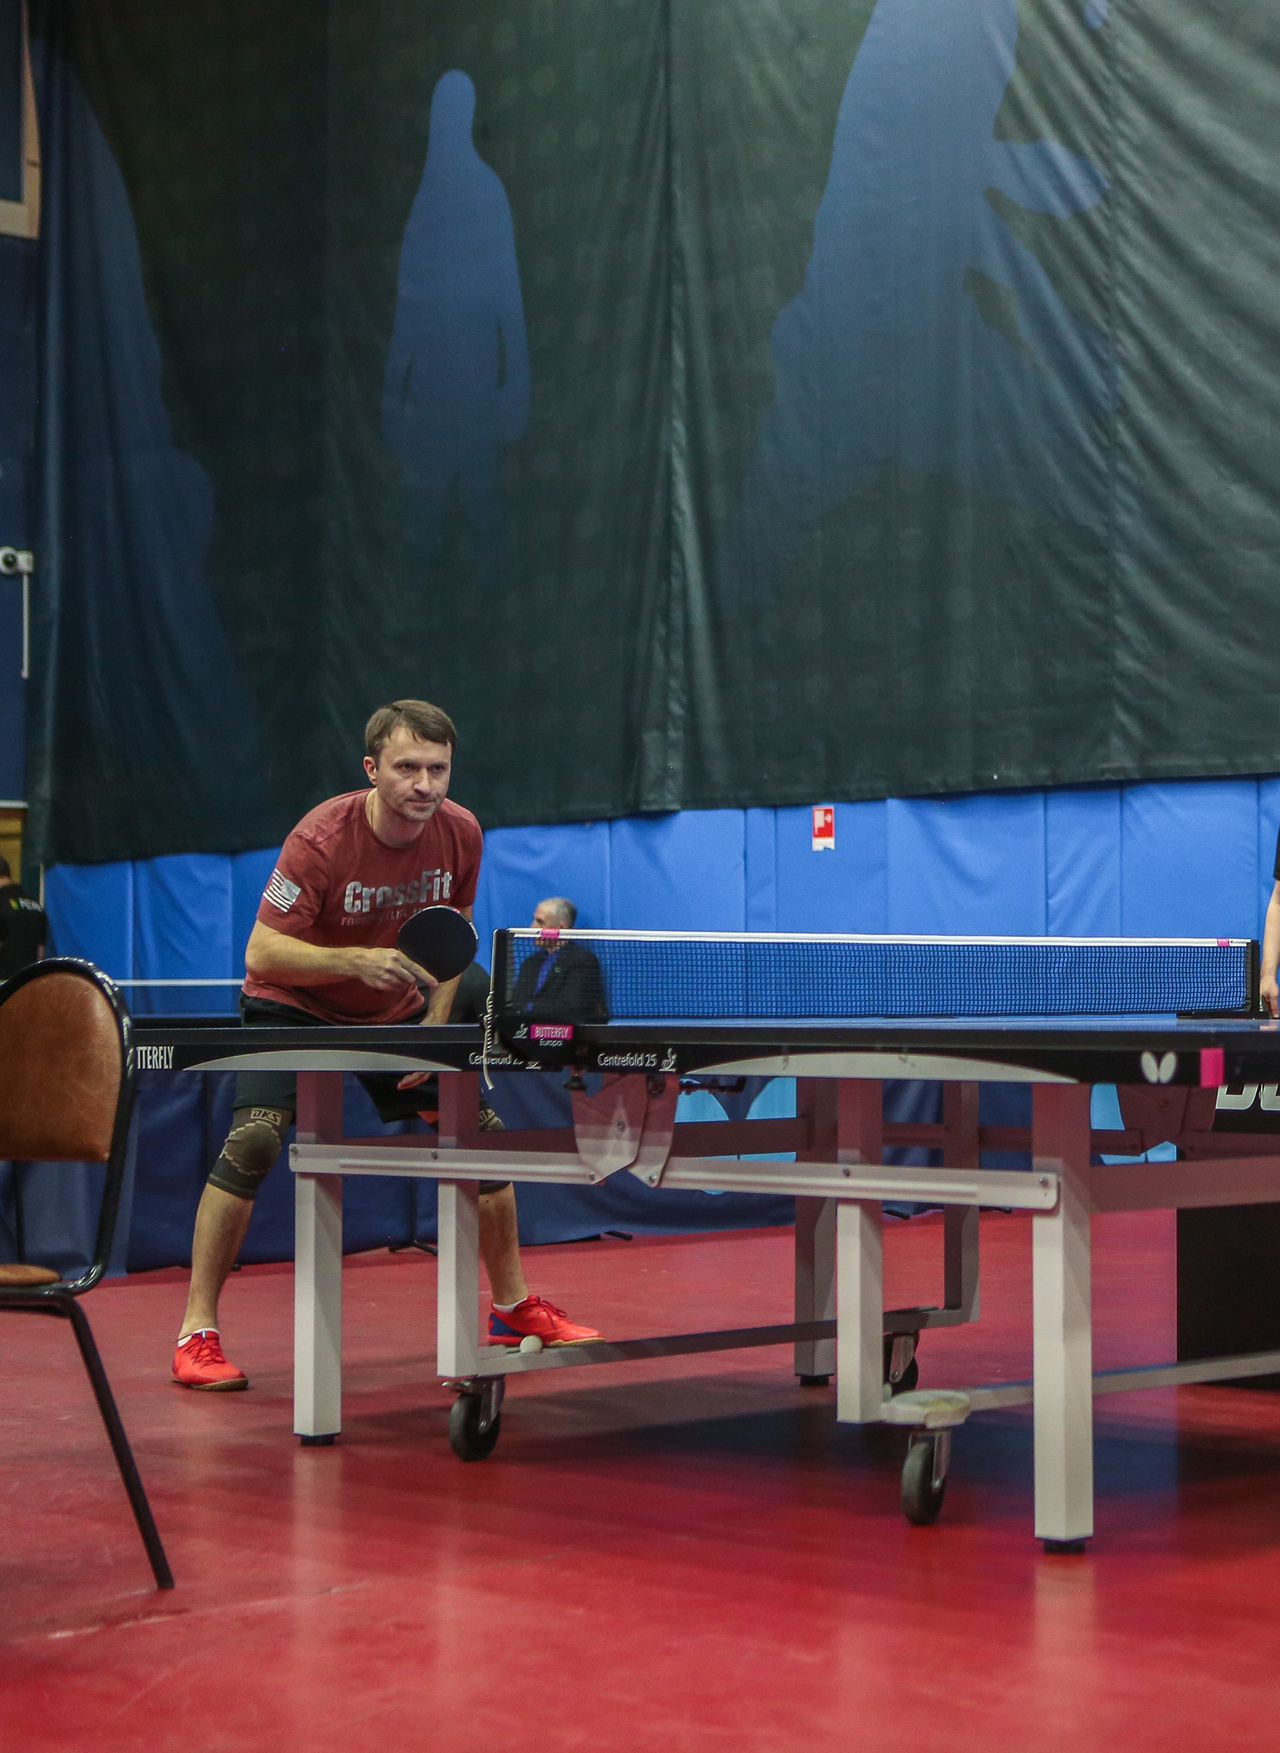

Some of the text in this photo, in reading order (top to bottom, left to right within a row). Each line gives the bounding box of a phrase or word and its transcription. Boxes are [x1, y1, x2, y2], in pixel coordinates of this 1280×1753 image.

[344, 868, 453, 914] CrossFit
[533, 1026, 570, 1038] BUTTERFLY
[597, 1053, 658, 1067] Centrefold 25
